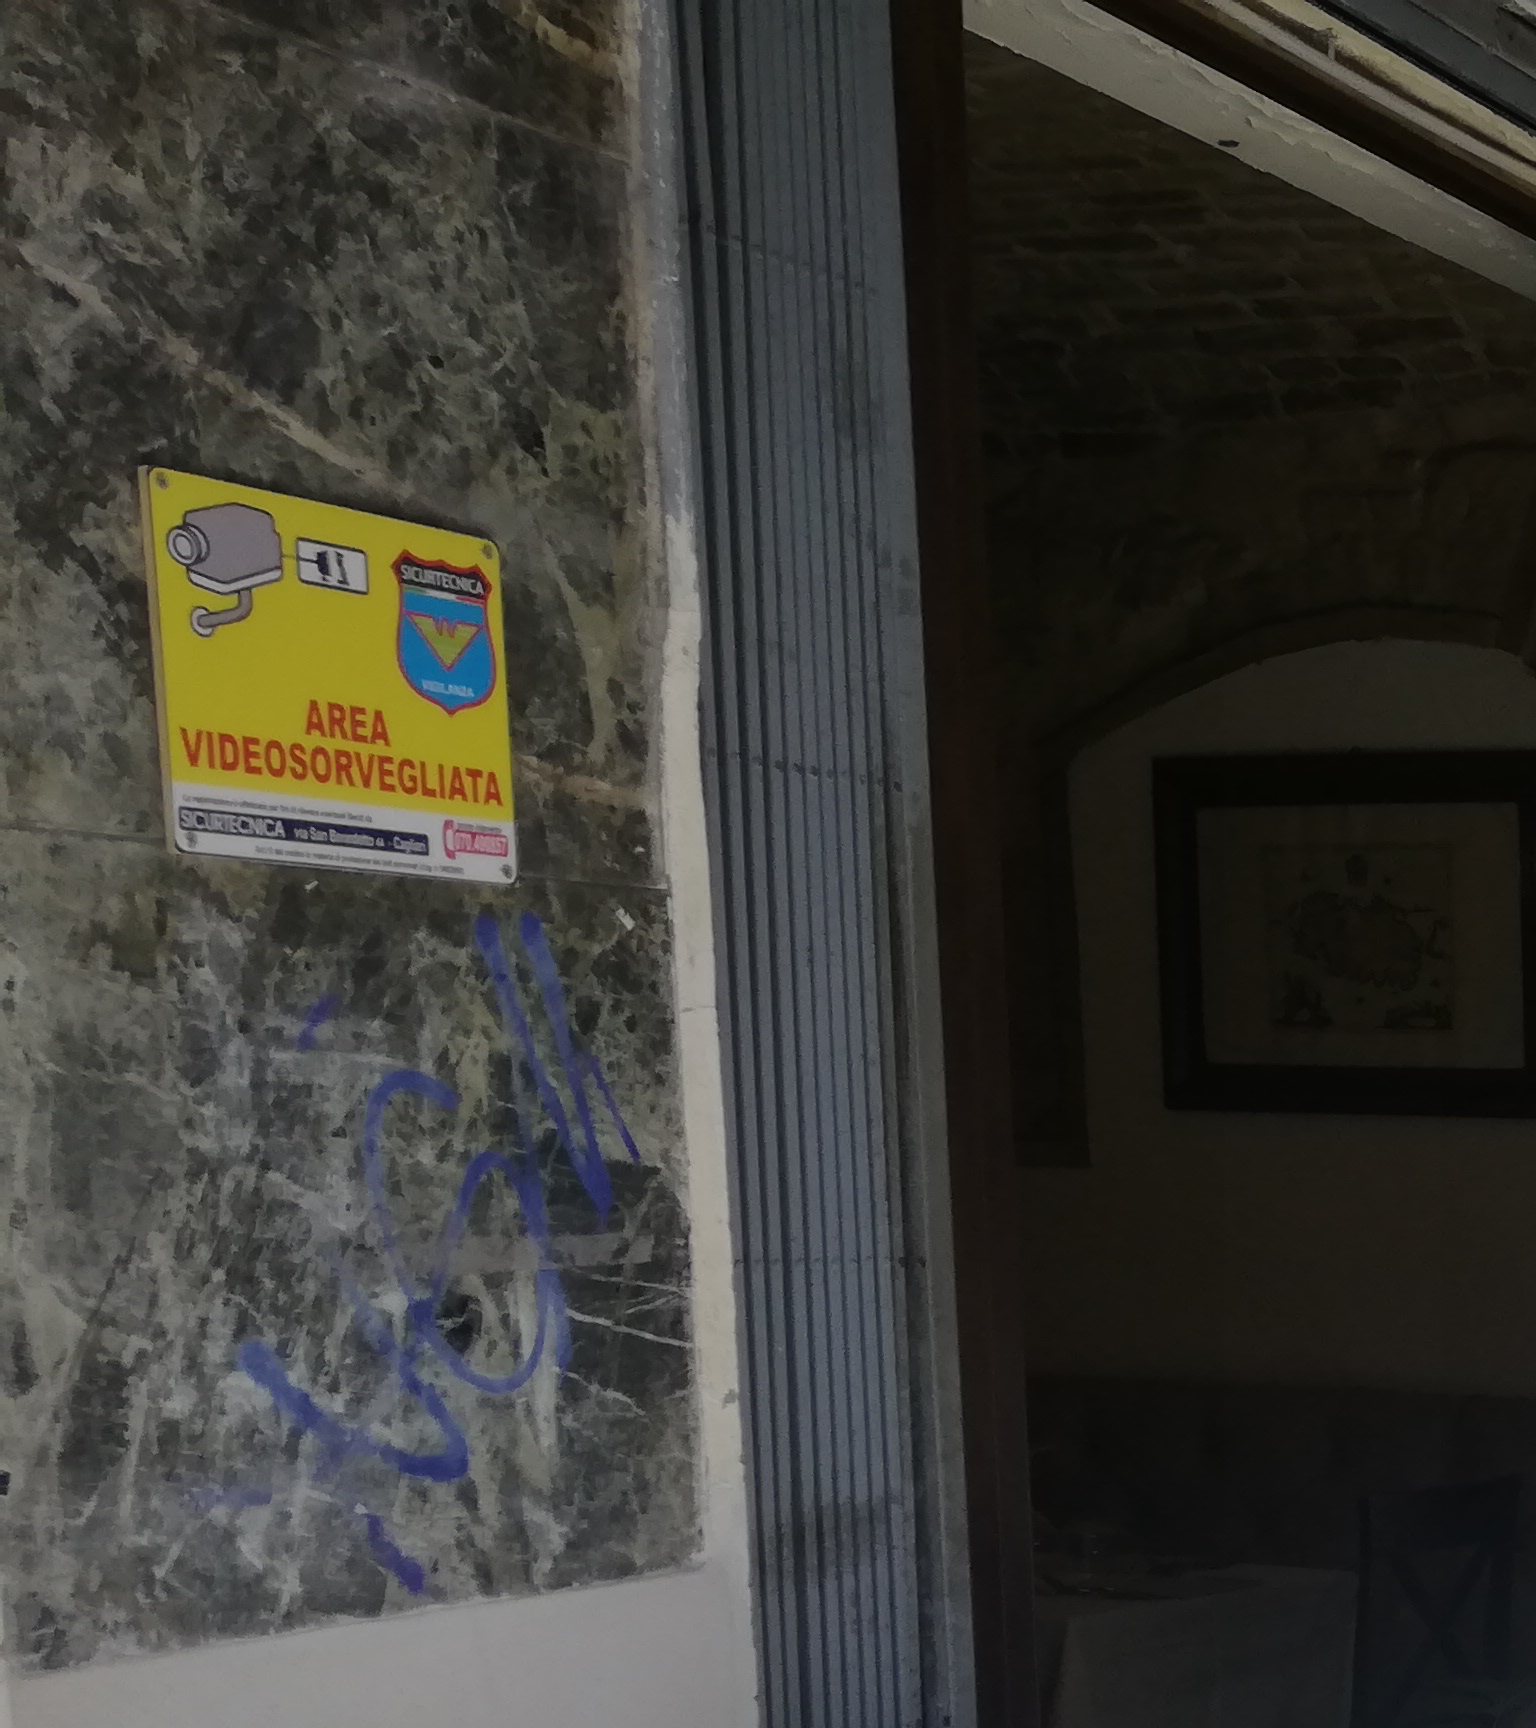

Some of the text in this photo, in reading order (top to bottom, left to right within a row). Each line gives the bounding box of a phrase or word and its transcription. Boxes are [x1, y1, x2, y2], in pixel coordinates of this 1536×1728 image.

[400, 564, 485, 595] SICURTECNICA
[304, 699, 391, 748] AREA
[179, 725, 505, 807] VIDEOSORVEGLIATA
[180, 810, 286, 839] SICURTECNICA
